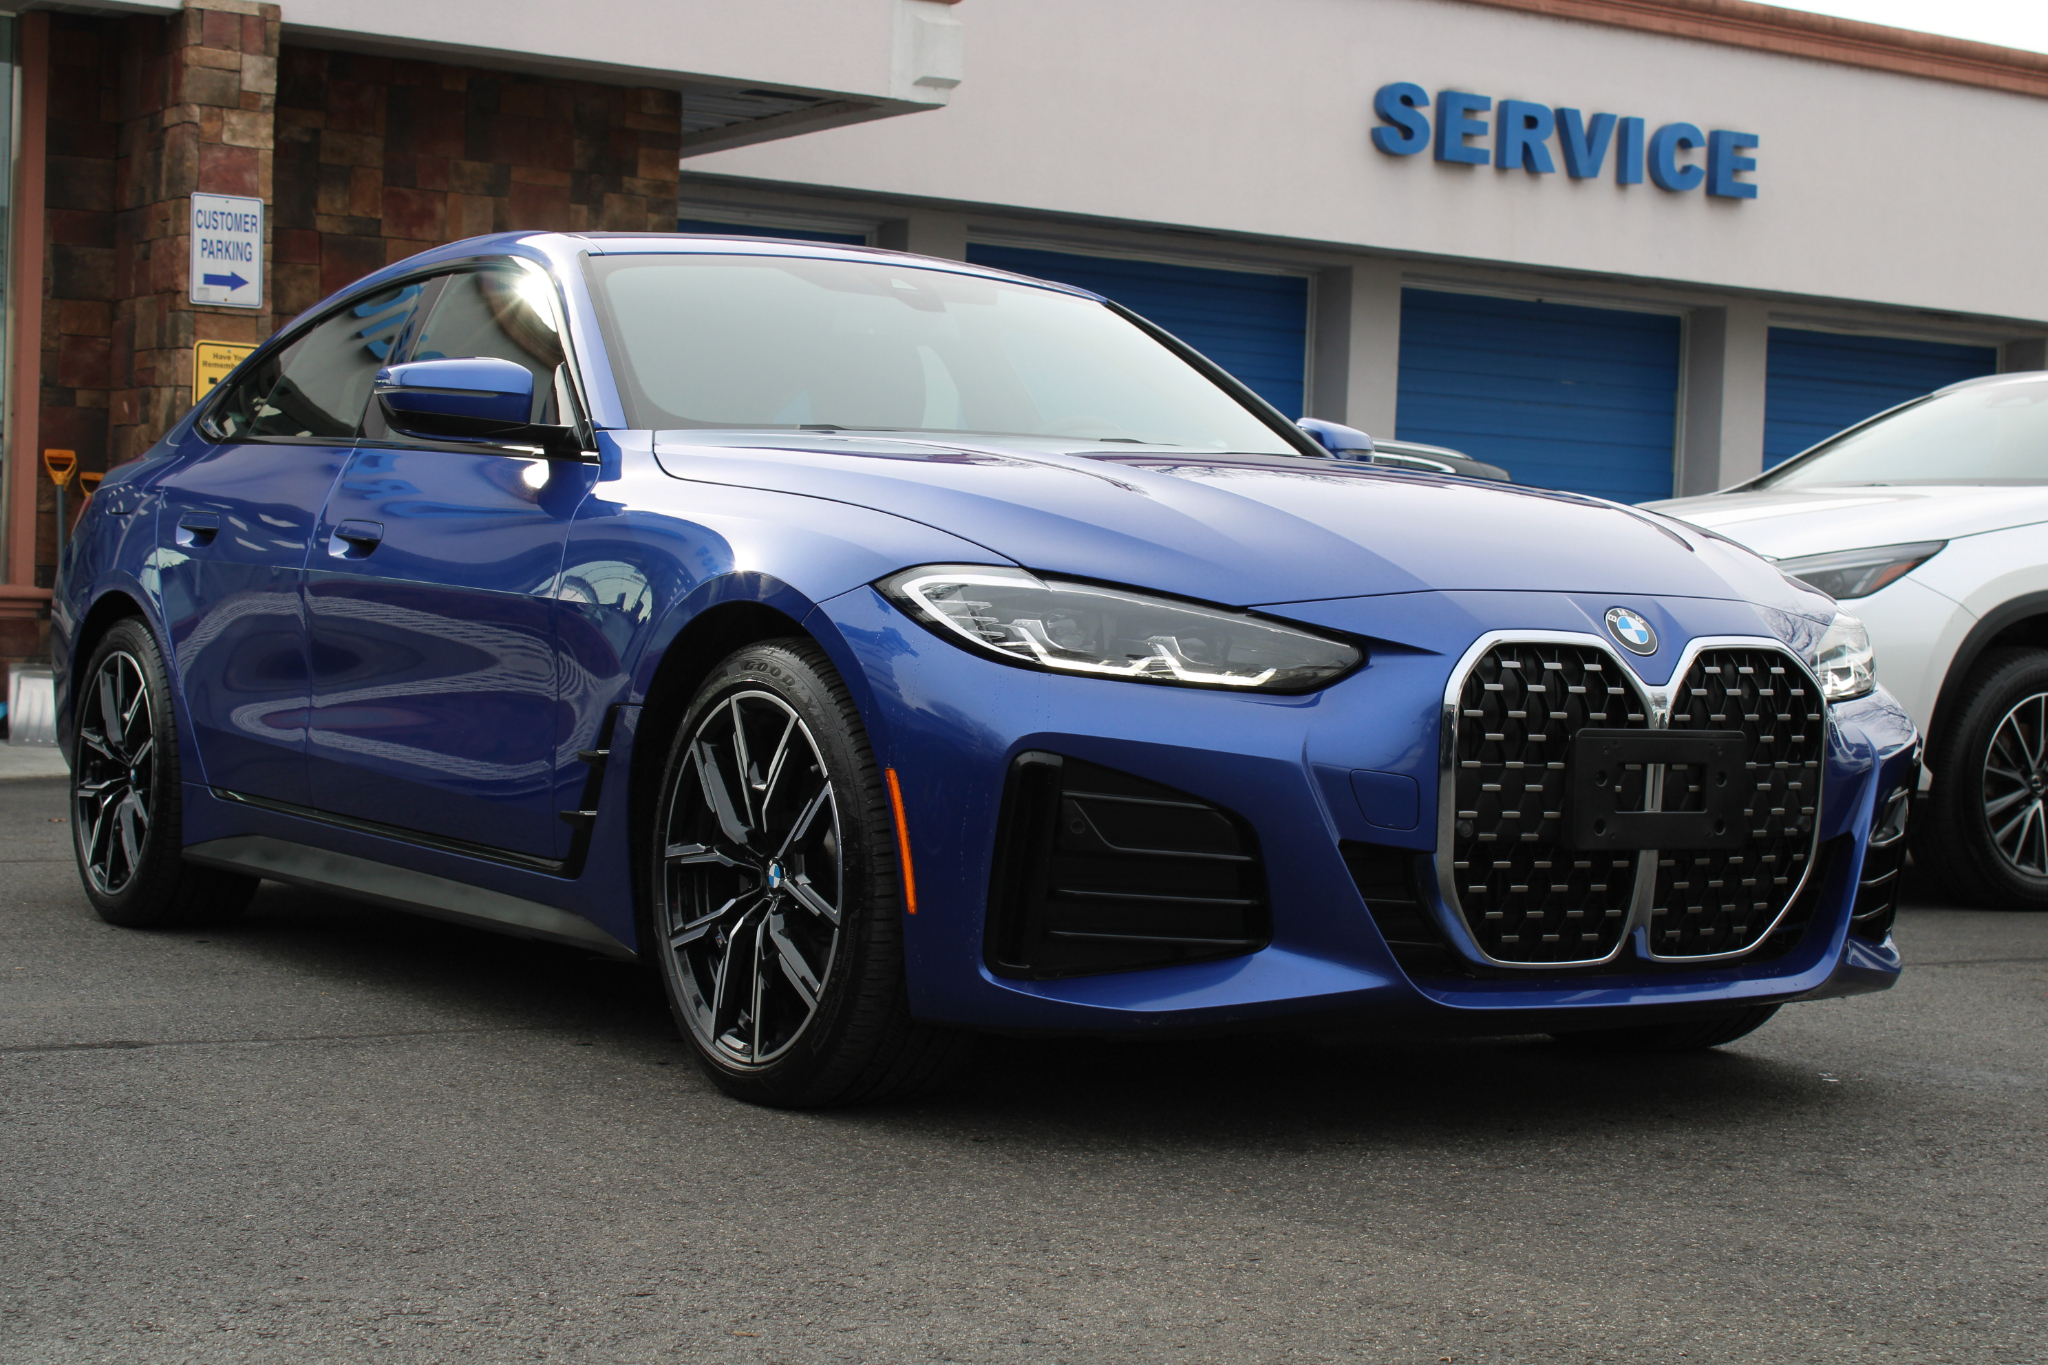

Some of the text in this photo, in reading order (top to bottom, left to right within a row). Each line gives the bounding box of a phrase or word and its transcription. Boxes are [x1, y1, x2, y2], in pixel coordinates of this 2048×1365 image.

[1371, 82, 1759, 199] SERVICE
[195, 209, 258, 234] CUSTOMER
[201, 238, 252, 262] PARKING
[212, 352, 231, 360] Have
[1607, 609, 1645, 624] BMW
